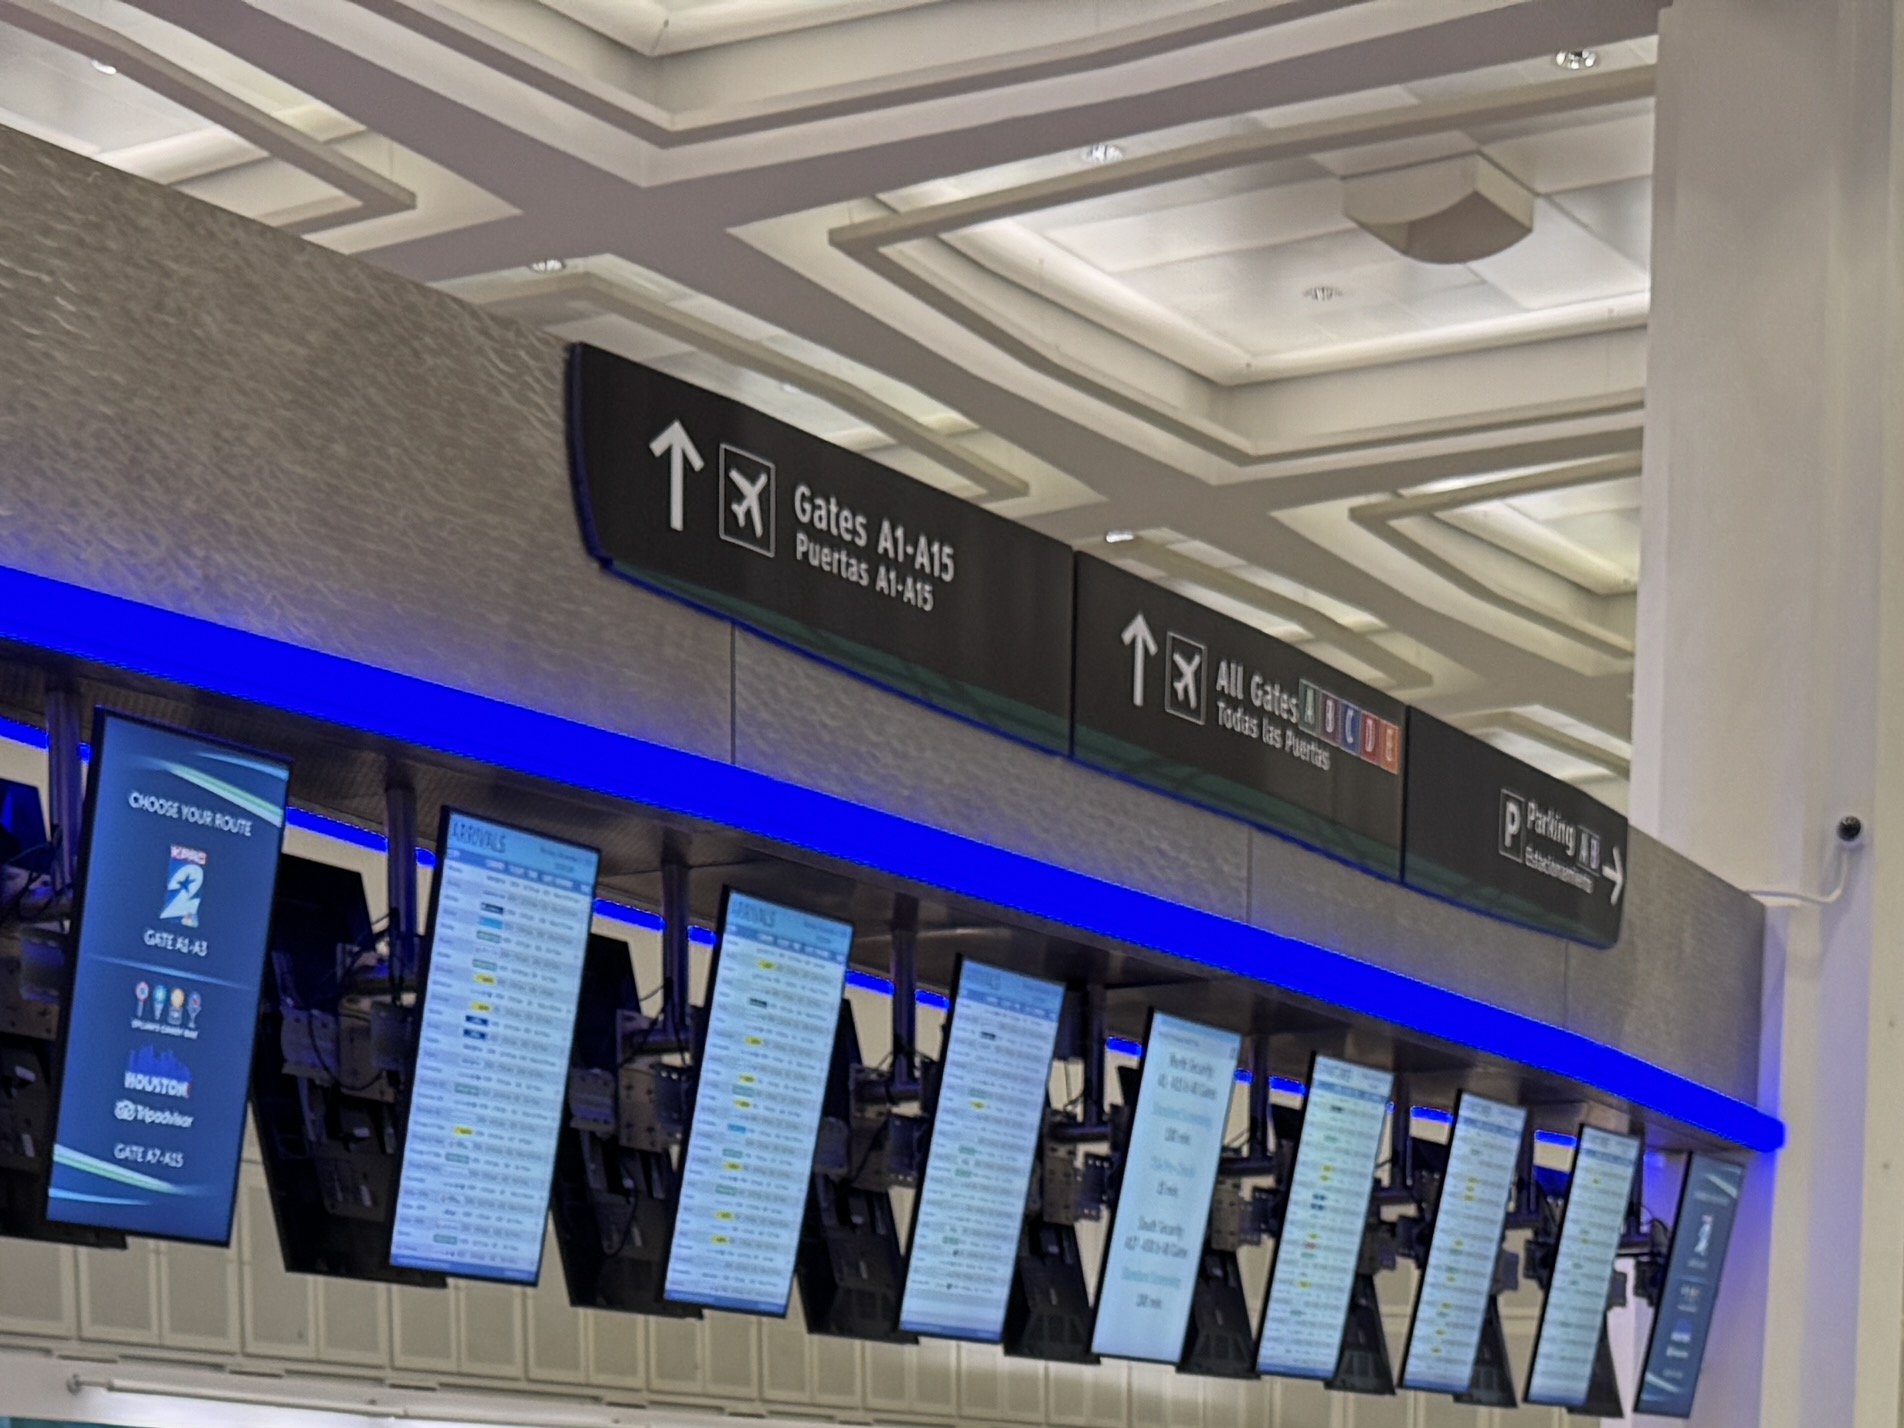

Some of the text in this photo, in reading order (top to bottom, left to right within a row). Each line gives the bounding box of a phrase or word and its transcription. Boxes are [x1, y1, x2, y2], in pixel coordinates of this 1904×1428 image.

[794, 484, 956, 584] Gates A1-A15
[795, 532, 935, 613] Puertas A1-A15
[1216, 659, 1244, 700] All
[1250, 673, 1300, 724] Gates
[1217, 701, 1331, 771] Todas las Puertas
[128, 792, 253, 837] CHOOSE YOUR ROUTE
[1527, 801, 1576, 857] Parking
[144, 929, 174, 950] GATE
[124, 1071, 190, 1099] HOUSTON
[114, 1142, 144, 1163] GATE
